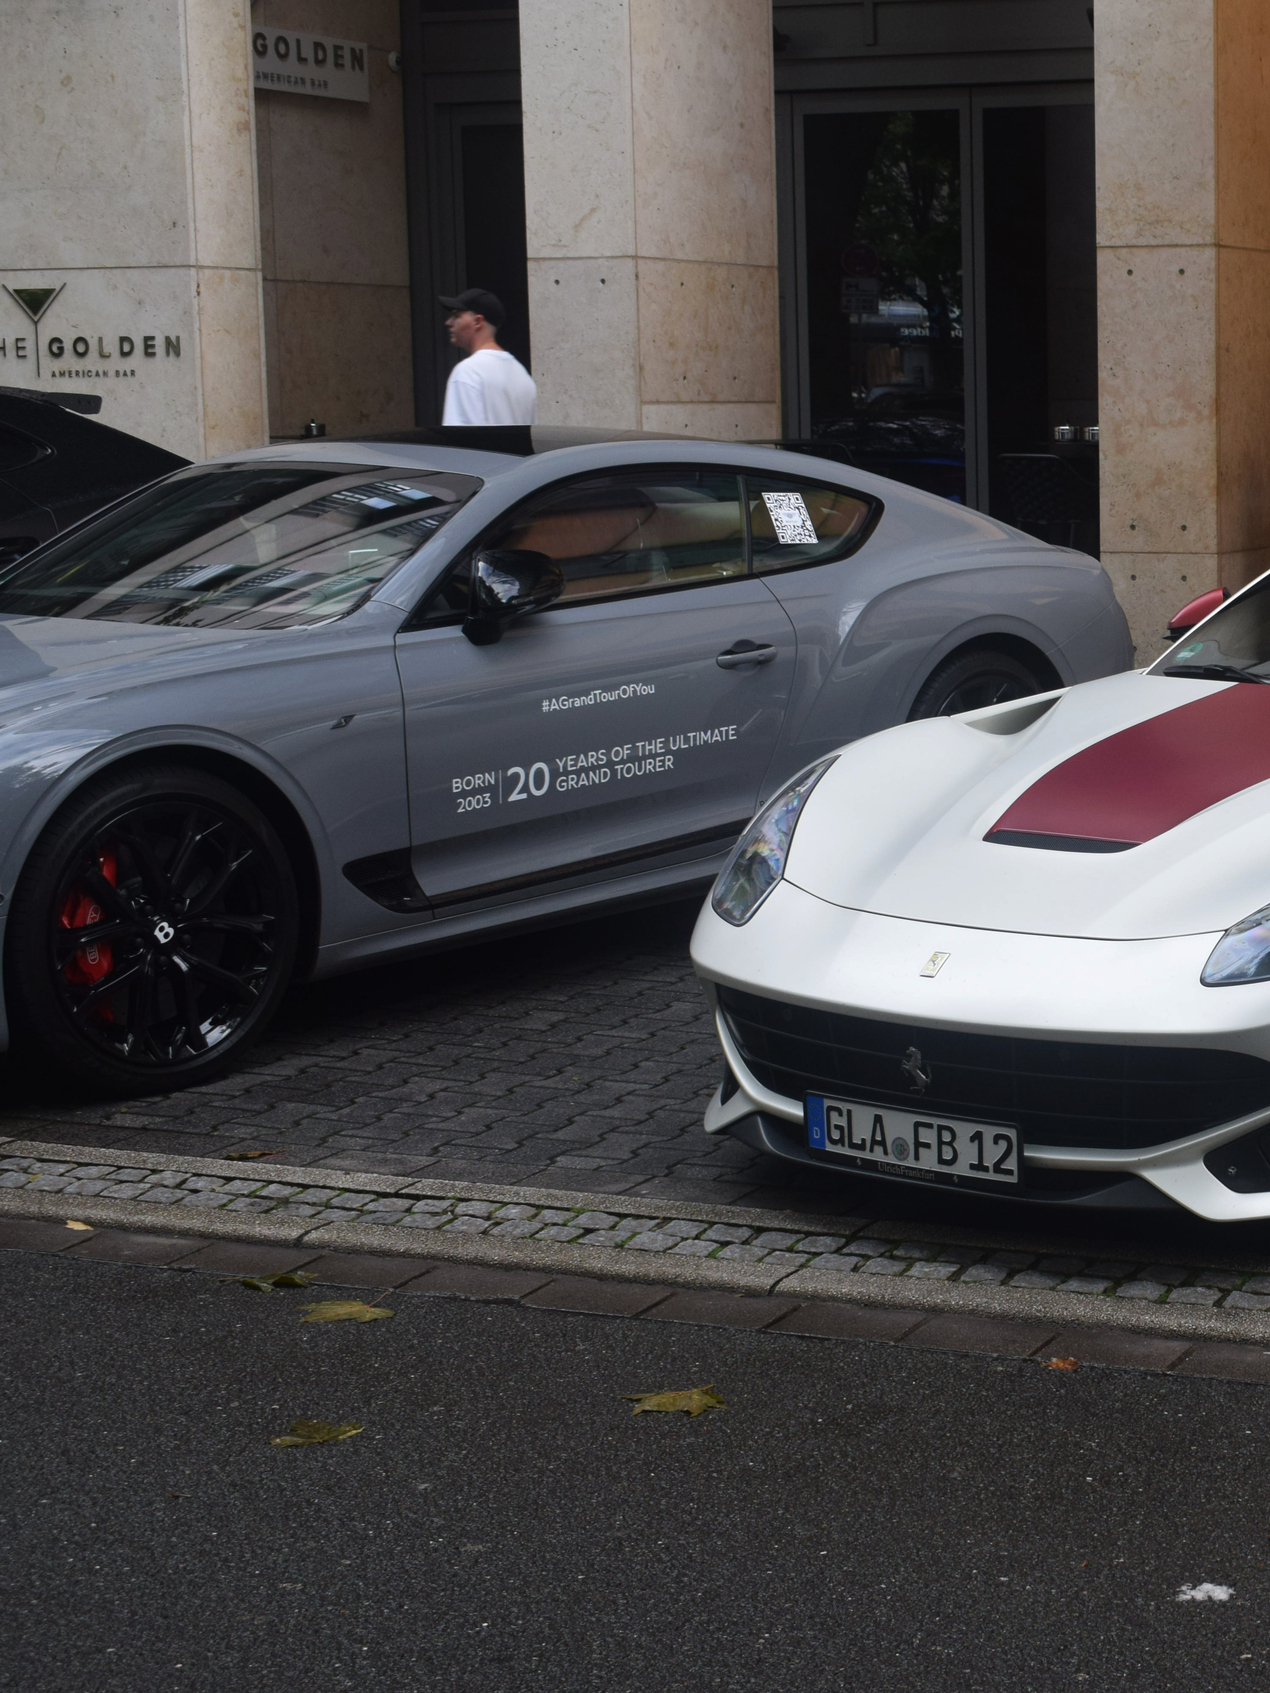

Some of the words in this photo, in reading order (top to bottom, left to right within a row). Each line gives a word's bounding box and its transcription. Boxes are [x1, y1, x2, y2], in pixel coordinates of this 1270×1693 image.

[252, 32, 365, 71] GOLDEN
[255, 70, 307, 88] AMERICAN
[309, 78, 329, 89] BAR
[0, 337, 28, 358] HE
[48, 335, 182, 358] GOLDEN
[51, 369, 109, 378] AMERICAN
[115, 369, 136, 378] BAR
[541, 683, 656, 712] #AGrandTourOfYou
[556, 750, 607, 773] YEARS
[611, 744, 632, 762] OF
[636, 738, 666, 757] THE
[669, 725, 738, 751] ULTIMATE
[452, 771, 495, 793] BORN
[506, 762, 550, 802] 20
[556, 767, 611, 792] GRAND
[614, 755, 674, 780] TOURER
[456, 793, 492, 813] 2003
[153, 921, 175, 944] B
[813, 1127, 820, 1138] D
[825, 1104, 889, 1156] GLA
[913, 1120, 959, 1166] FB
[969, 1130, 1015, 1176] 12
